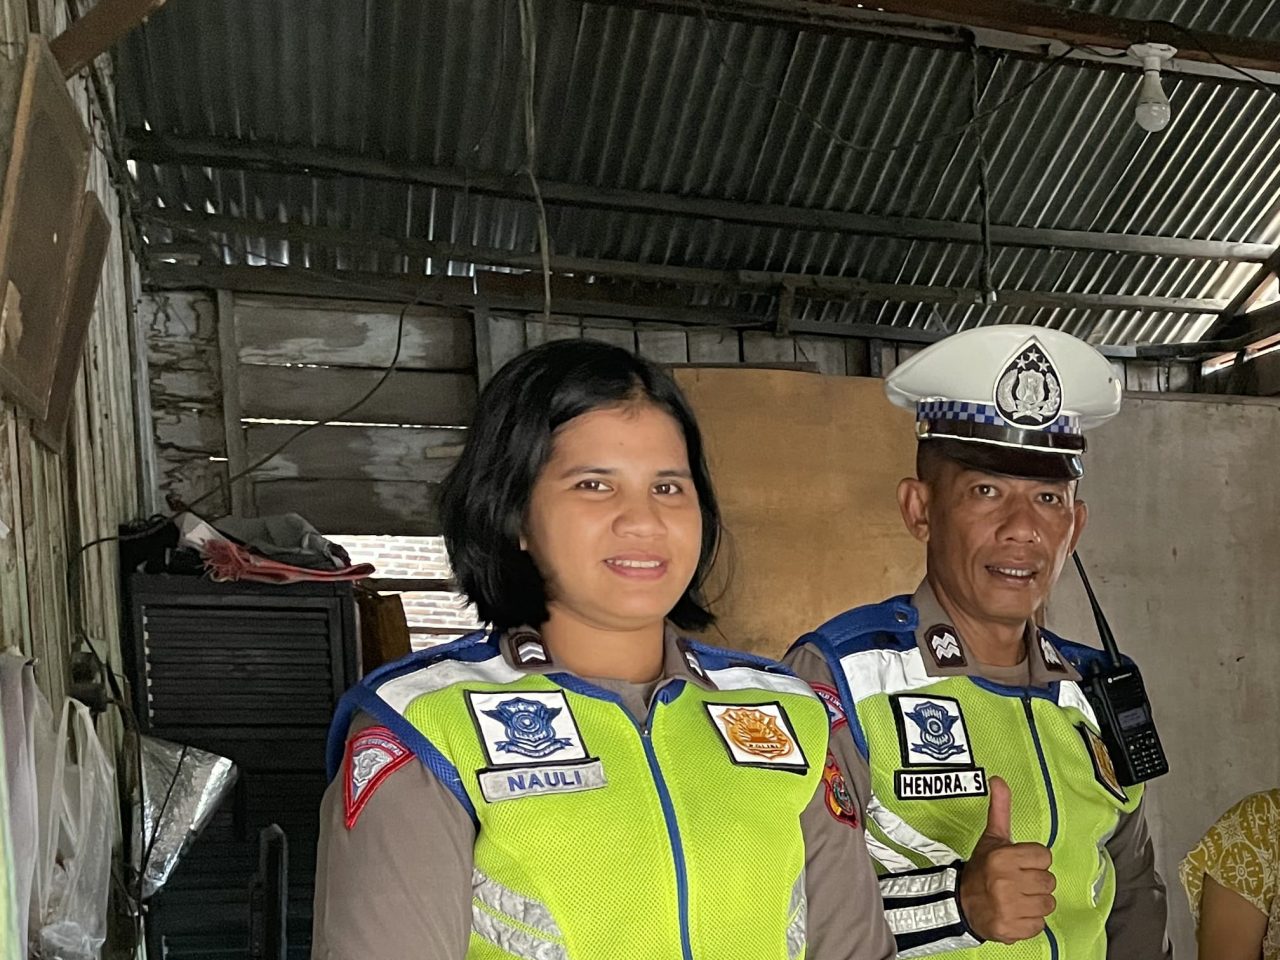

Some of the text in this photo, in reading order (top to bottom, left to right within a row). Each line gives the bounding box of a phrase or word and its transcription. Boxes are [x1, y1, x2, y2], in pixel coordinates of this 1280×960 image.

[507, 770, 583, 792] NAULI
[903, 772, 982, 795] HENDRA. S
